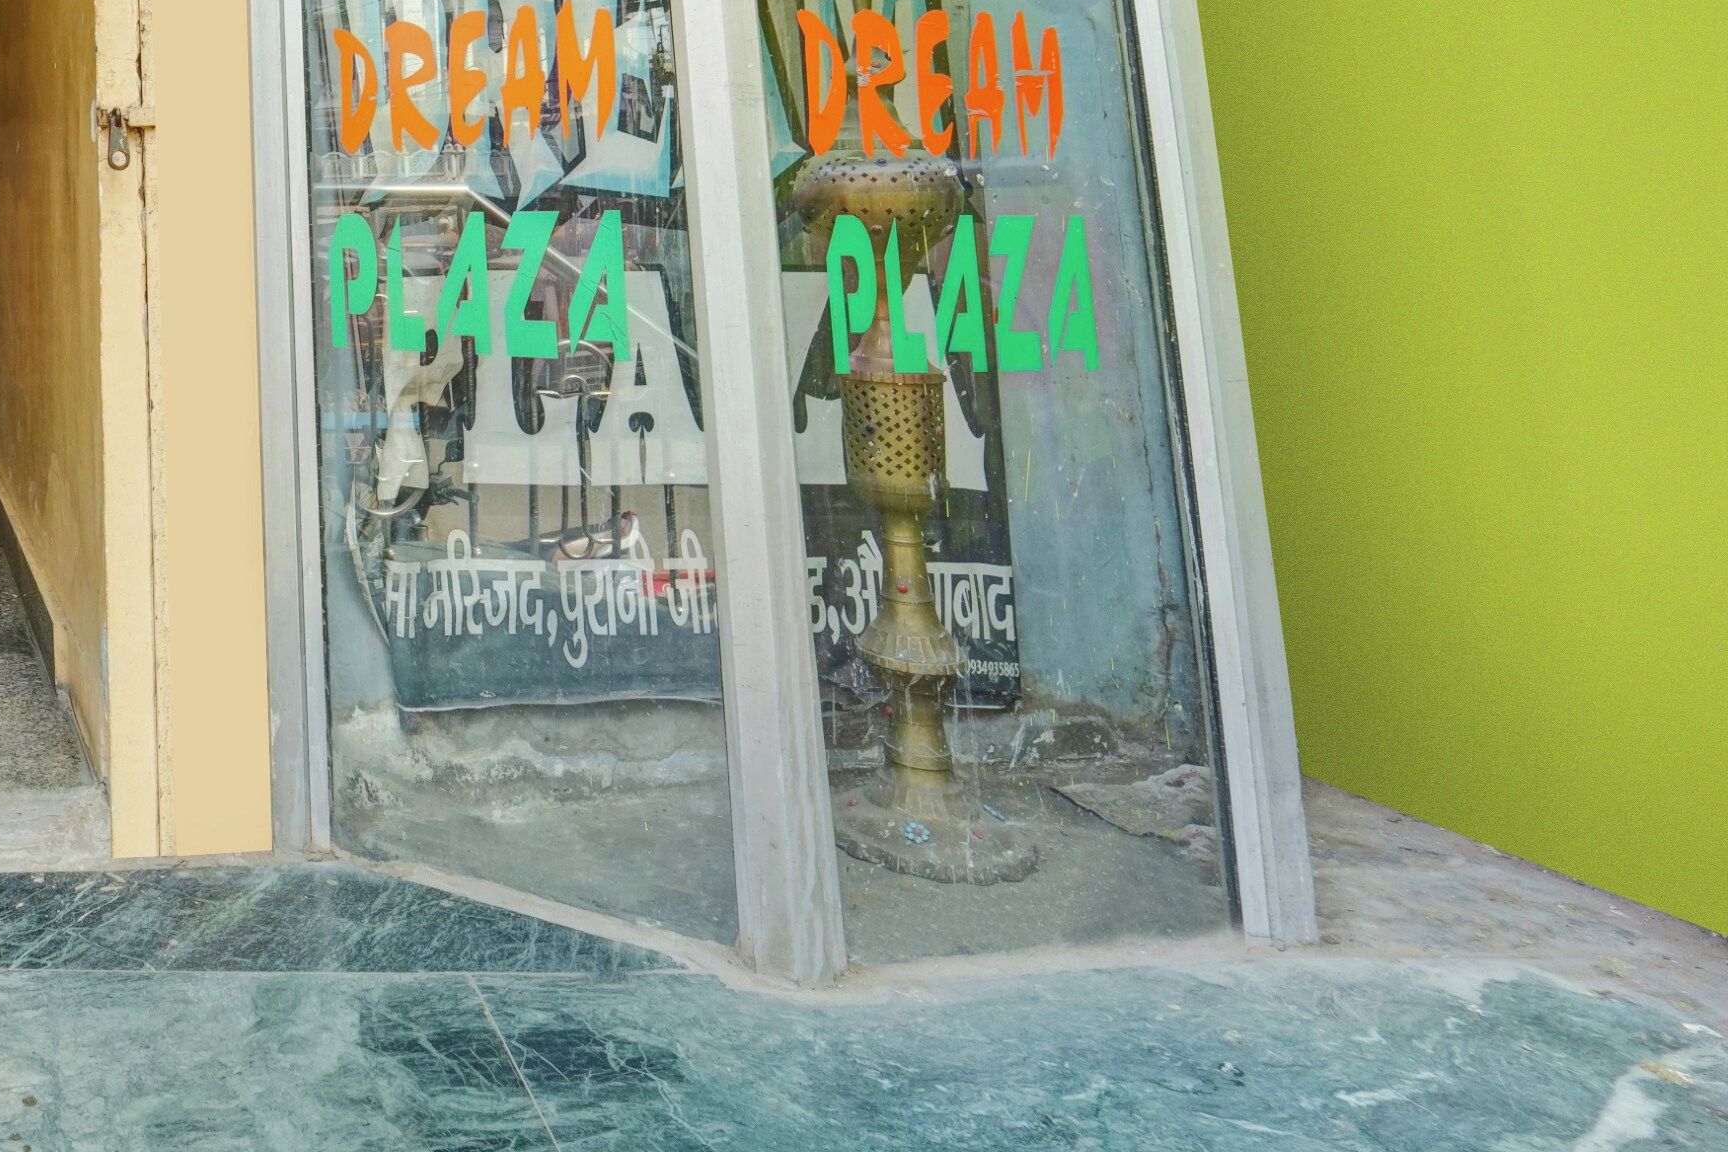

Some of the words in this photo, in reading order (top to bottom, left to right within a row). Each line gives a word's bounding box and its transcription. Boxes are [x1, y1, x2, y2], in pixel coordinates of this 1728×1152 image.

[332, 0, 617, 155] DREAM
[796, 8, 1064, 161] DREAM
[329, 210, 632, 362] PLAZA
[826, 214, 1100, 375] PLAZA
